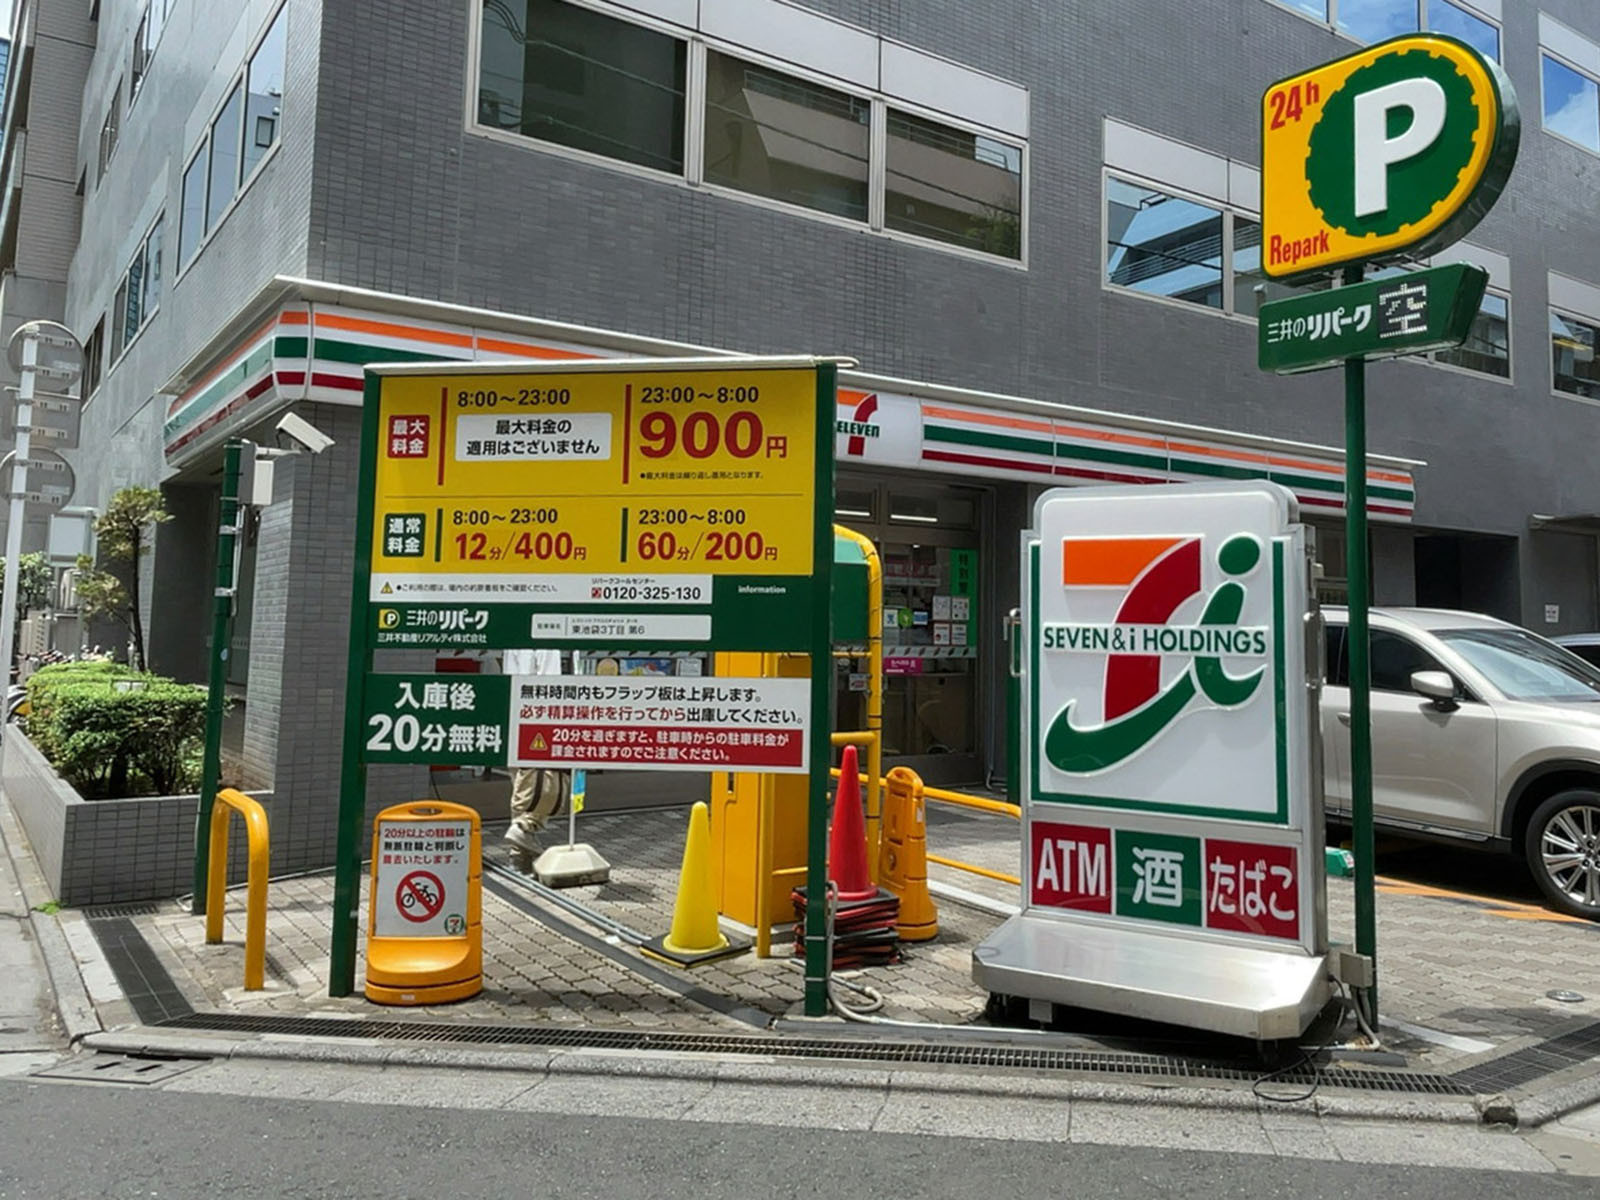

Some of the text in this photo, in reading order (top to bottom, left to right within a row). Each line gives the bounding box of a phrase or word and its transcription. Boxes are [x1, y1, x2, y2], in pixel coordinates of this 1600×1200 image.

[1354, 77, 1447, 218] P
[1269, 229, 1330, 266] Repark
[1267, 304, 1372, 342] 三井のリパーク
[392, 419, 426, 435] 最大
[496, 418, 572, 435] 最大料金の
[639, 410, 788, 459] 900円
[391, 436, 425, 455] 料金
[467, 437, 600, 456] 適用はございません
[388, 517, 421, 534] 通常
[387, 536, 420, 554] 料金
[603, 587, 701, 601] 0120-325-130
[738, 585, 786, 595] information
[406, 608, 489, 630] 三井のリパーク
[377, 632, 487, 644] 三井不動産リアルティ株式会社
[1143, 628, 1266, 655] HOLDINGS
[394, 682, 476, 712] 入庫後
[520, 685, 762, 703] 無料時間内もフラップ板は上昇します。
[520, 704, 804, 724] 必ず精算操作を行ってから出庫してください。
[366, 714, 503, 754] 20分無料
[552, 727, 789, 748] 20分を過ぎますと、駐車時からの駐車料金が
[551, 744, 732, 762] 課金されますのでご注意ください。
[1037, 837, 1106, 897] ATM
[1131, 846, 1184, 908] 酒
[1209, 856, 1296, 921] たばこ
